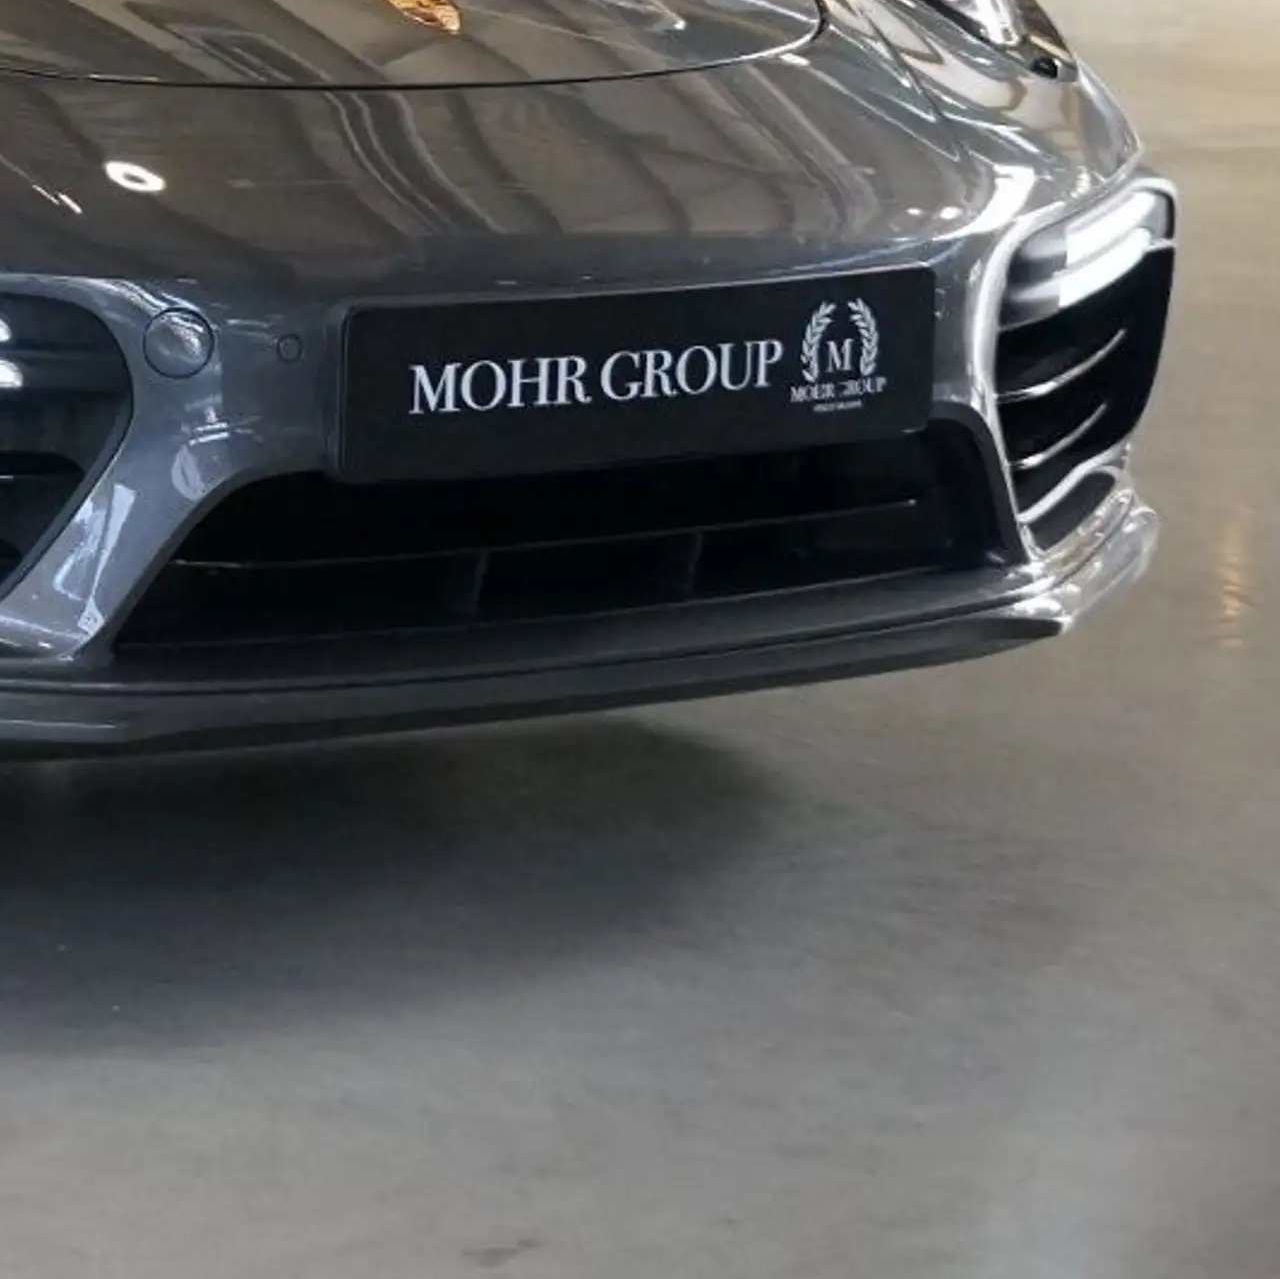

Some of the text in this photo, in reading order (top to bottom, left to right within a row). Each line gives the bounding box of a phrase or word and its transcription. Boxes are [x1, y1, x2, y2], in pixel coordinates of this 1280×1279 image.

[408, 339, 784, 415] MOHR GROUP
[825, 338, 854, 373] M
